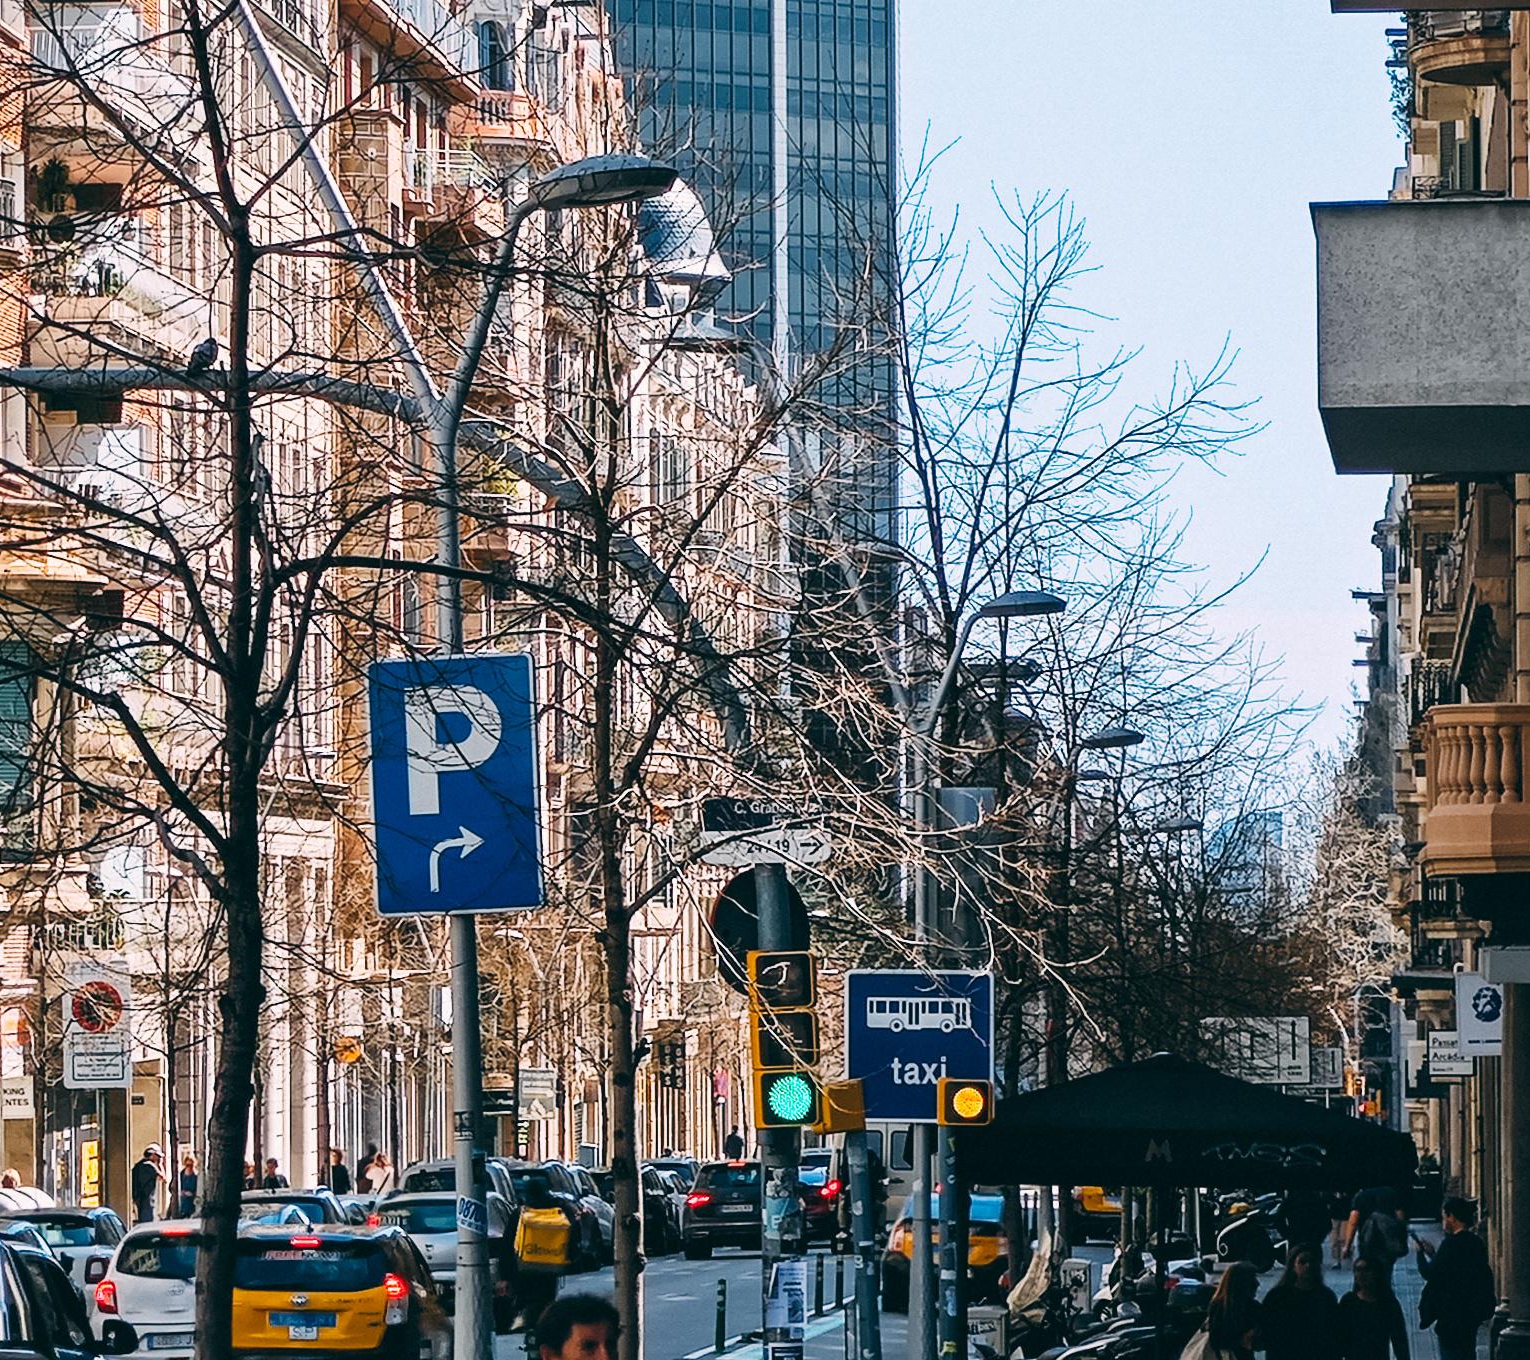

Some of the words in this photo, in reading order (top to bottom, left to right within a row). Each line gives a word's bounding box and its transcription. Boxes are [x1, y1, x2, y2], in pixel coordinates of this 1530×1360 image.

[404, 684, 502, 816] P
[775, 839, 791, 853] 19
[891, 1055, 947, 1086] taxi
